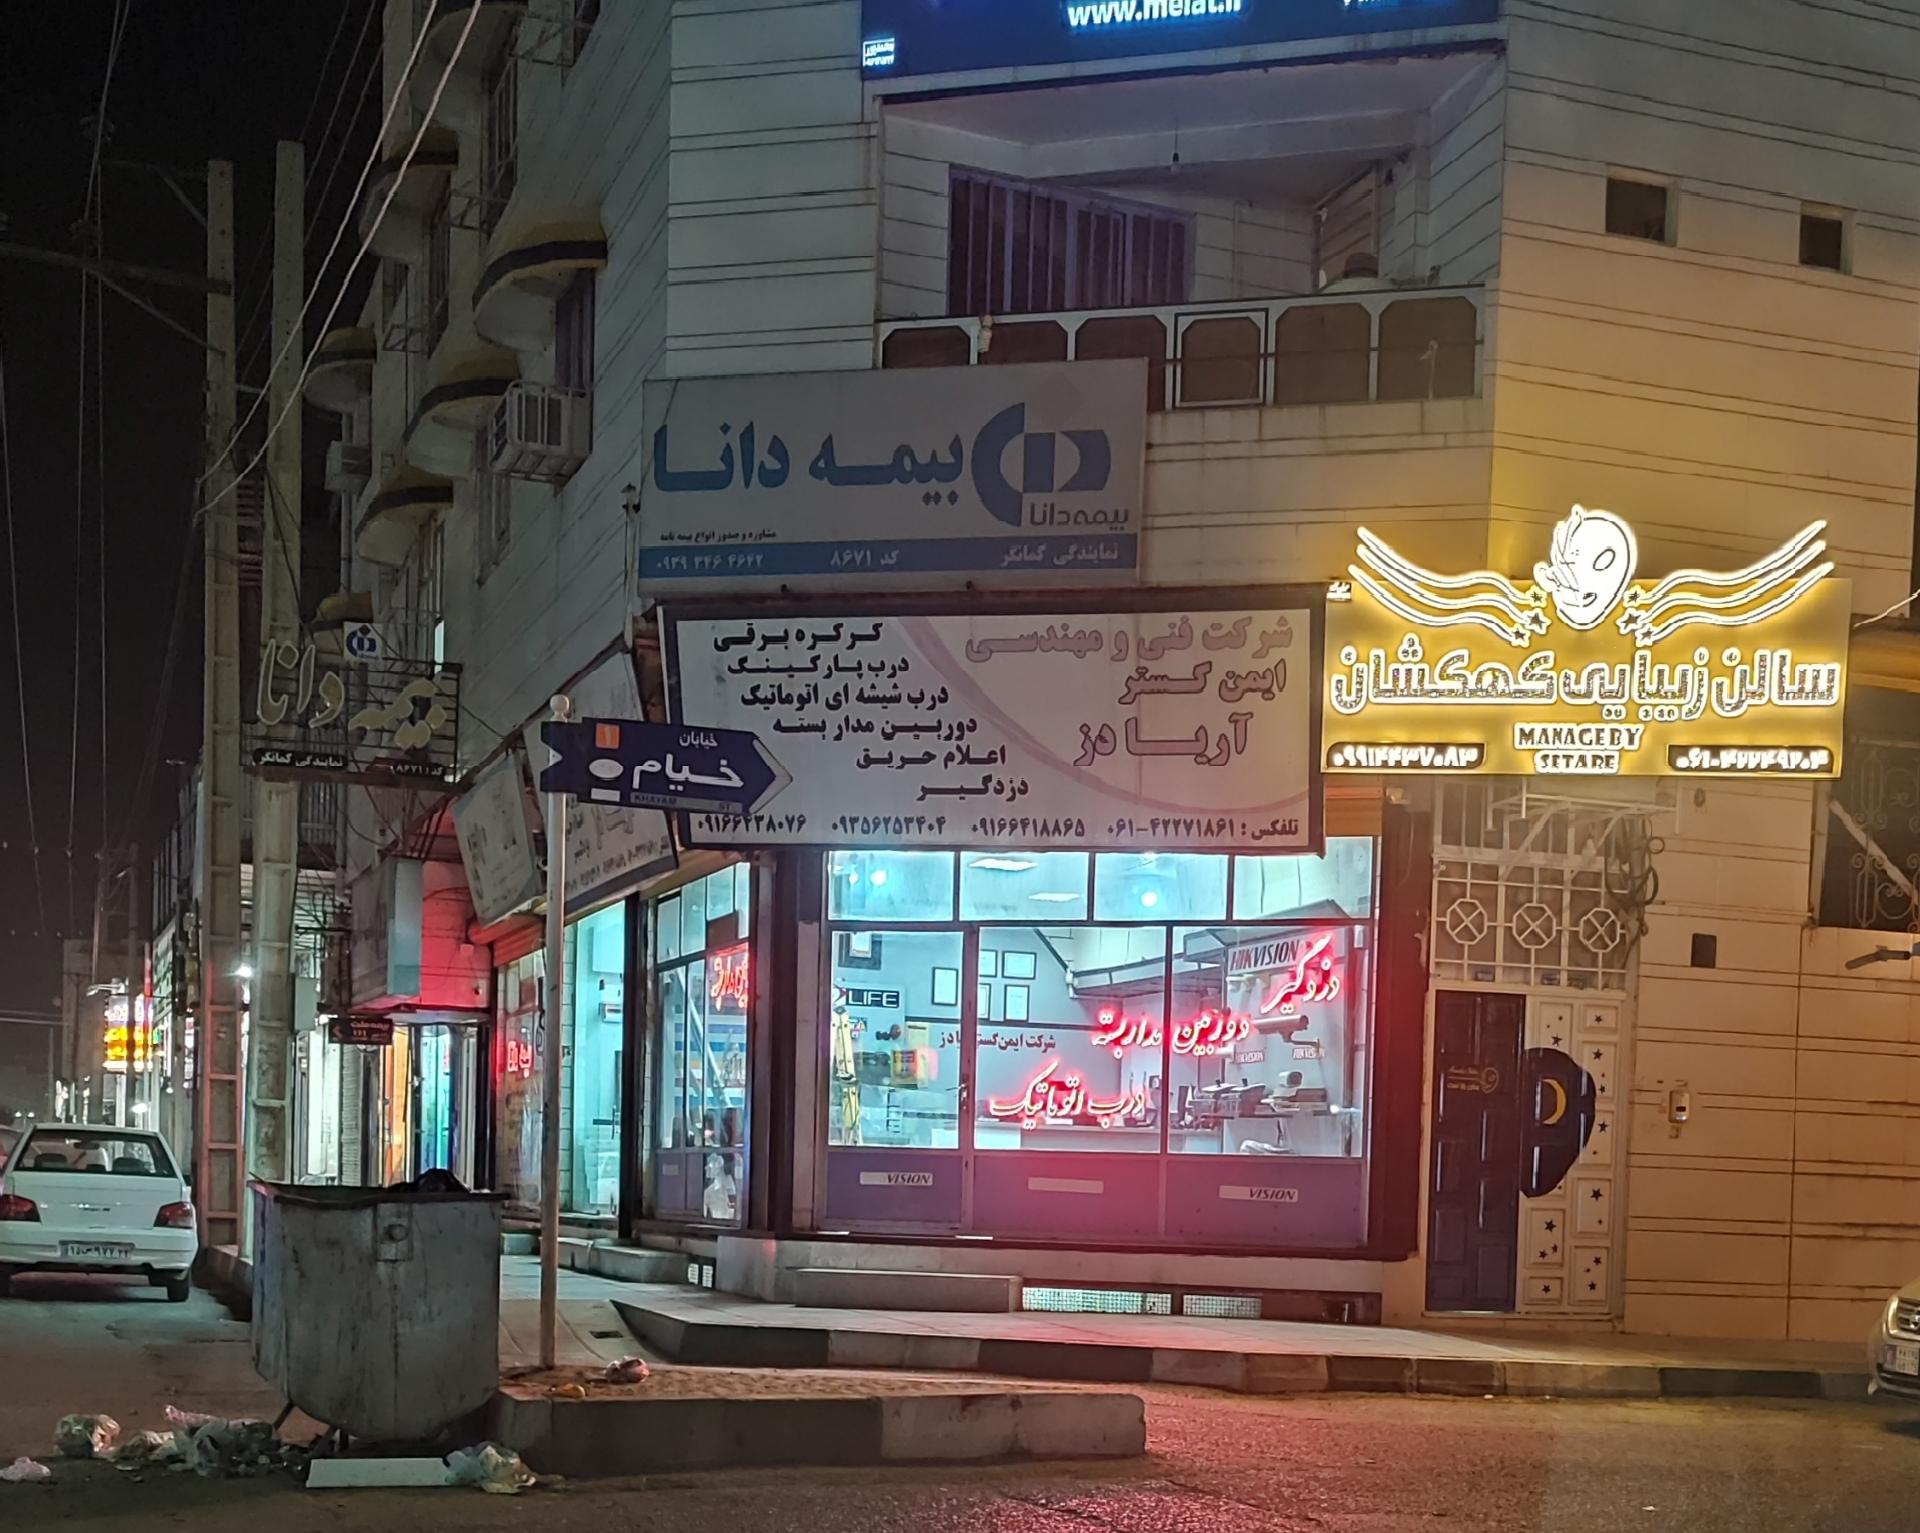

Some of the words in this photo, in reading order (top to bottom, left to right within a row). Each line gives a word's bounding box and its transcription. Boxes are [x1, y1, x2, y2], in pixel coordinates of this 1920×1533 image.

[653, 420, 790, 492] دانا
[809, 432, 964, 506] بیمه
[879, 549, 900, 566] کد
[1053, 542, 1119, 566] نمایندگی
[713, 623, 790, 652] برقی
[795, 622, 883, 651] کرکره
[965, 623, 1104, 663] مهندسی
[1110, 630, 1129, 661] و
[1137, 616, 1193, 661] فنی
[1201, 615, 1294, 659] شرکت
[867, 657, 910, 678] درب
[1218, 658, 1287, 702] ایمن
[1331, 633, 1557, 715] کهکشان
[855, 683, 902, 709] شیشه
[1562, 646, 1710, 721] زیبایی
[1712, 647, 1840, 717] سالن
[825, 683, 849, 711] ای
[906, 686, 949, 711] درب
[678, 731, 719, 749] خیابان
[772, 717, 827, 741] بسته
[832, 714, 875, 741] مدار
[880, 715, 978, 741] دوربین
[1125, 712, 1254, 766] آریا
[856, 747, 937, 770] حریق
[943, 744, 1006, 770] اعلام
[1073, 723, 1117, 766] دز
[631, 753, 745, 791] خیام
[1537, 752, 1618, 771] SETARE
[915, 774, 1029, 802] دزدگیر
[1229, 938, 1301, 971] HIKVISION
[848, 989, 898, 1008] LIFE
[977, 1032, 999, 1046] گست
[998, 1033, 1024, 1051] ایمن
[1026, 1034, 1056, 1053] شرکت
[1087, 1090, 1147, 1129] درب
[886, 1172, 932, 1186] VISION
[1248, 1187, 1297, 1201] VISION
